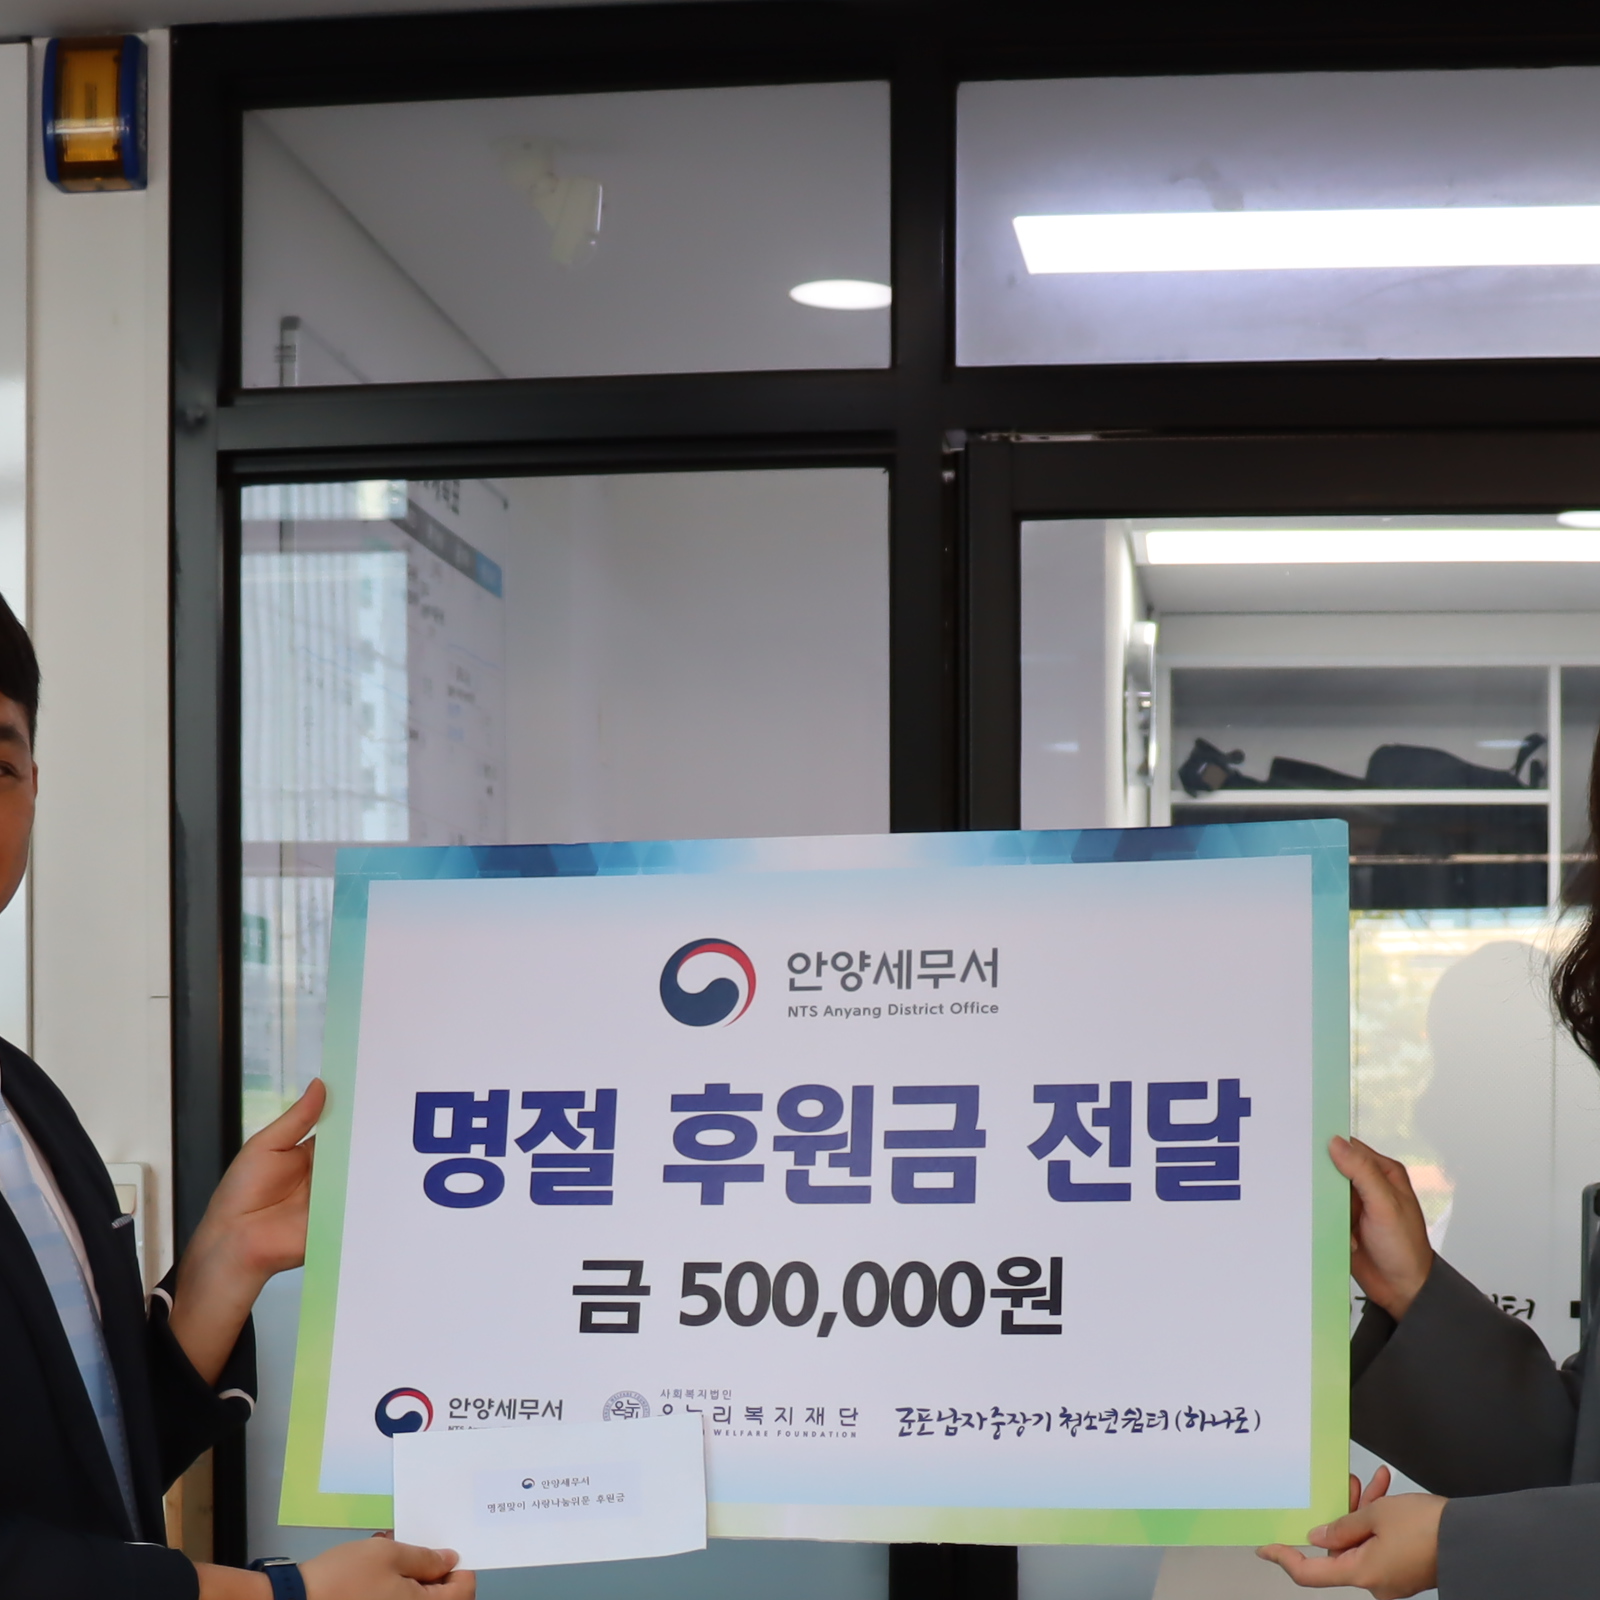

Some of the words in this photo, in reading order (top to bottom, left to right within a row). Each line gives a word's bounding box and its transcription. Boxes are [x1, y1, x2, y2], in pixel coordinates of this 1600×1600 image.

[787, 947, 1000, 992] 안양세무서
[787, 1004, 819, 1019] NTS
[823, 1004, 882, 1020] Anyang
[887, 1002, 945, 1017] District
[949, 1001, 1000, 1016] Office
[412, 1088, 618, 1210] 명절
[662, 1082, 987, 1207] 후원금
[1026, 1078, 1252, 1203] 전달
[571, 1258, 652, 1335] 금
[679, 1255, 1064, 1339] 500,000원
[660, 1388, 733, 1401] 사회복지법인
[449, 1397, 563, 1421] 안양세무서
[713, 1428, 769, 1437] WELFARE
[776, 1429, 857, 1439] FOUNDATION
[541, 1476, 590, 1489] 안양세무서
[595, 1493, 626, 1504] 후원금
